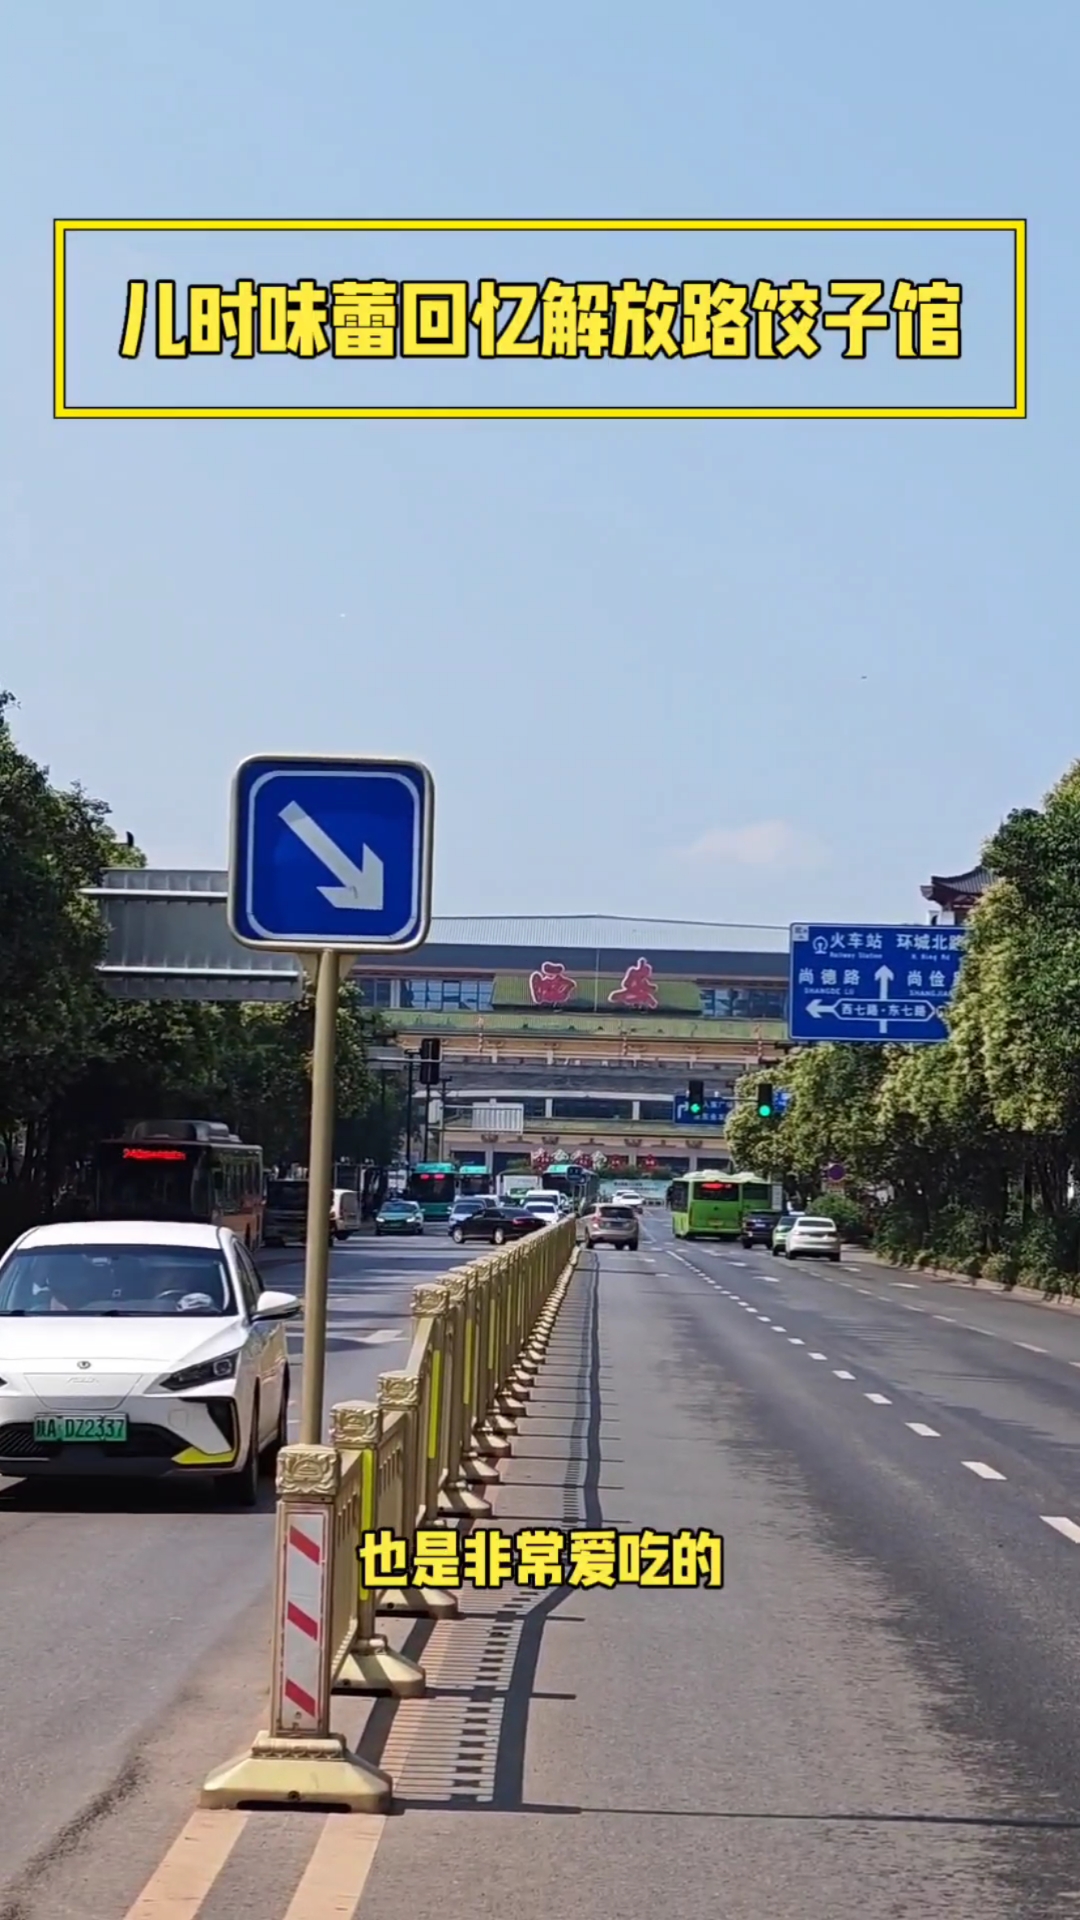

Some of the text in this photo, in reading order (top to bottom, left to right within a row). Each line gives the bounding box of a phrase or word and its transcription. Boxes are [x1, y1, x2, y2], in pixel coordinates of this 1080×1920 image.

[830, 932, 883, 949] 火车站
[799, 967, 860, 985] 尚德路
